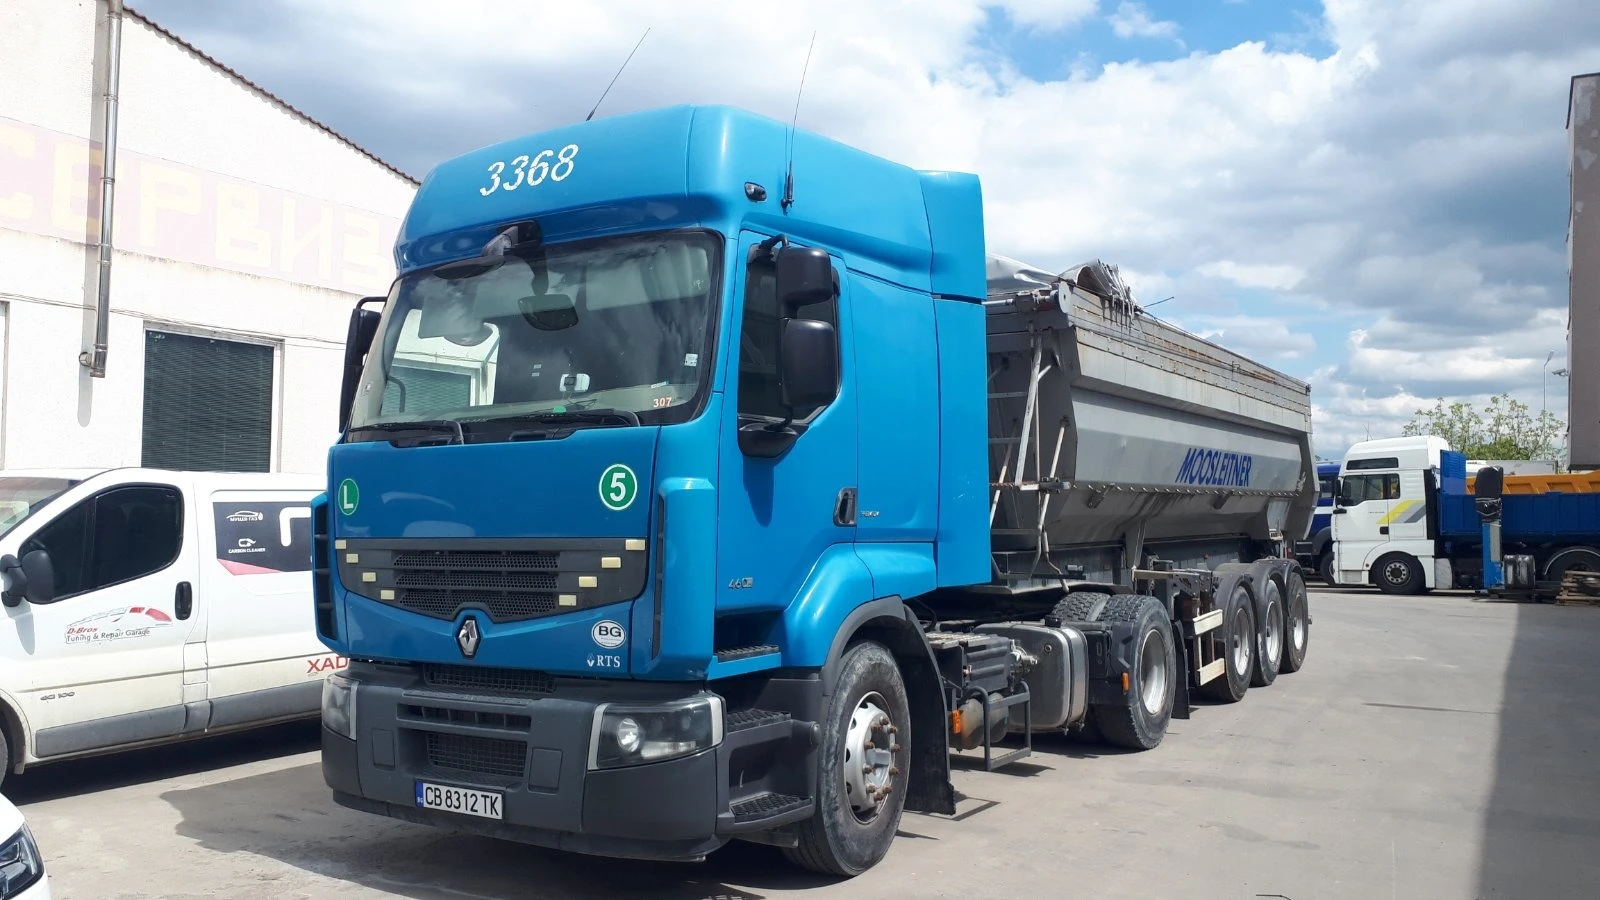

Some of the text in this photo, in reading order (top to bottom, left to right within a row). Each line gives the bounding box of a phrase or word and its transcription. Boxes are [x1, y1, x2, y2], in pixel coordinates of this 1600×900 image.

[480, 144, 579, 196] 3368
[653, 397, 672, 408] 307
[1175, 447, 1252, 487] MOOSLEITNER
[609, 472, 627, 502] 5
[343, 485, 354, 509] L
[66, 634, 91, 642] Tuning
[101, 629, 124, 640] Repair
[125, 627, 151, 638] Garage
[598, 625, 622, 638] BG
[596, 654, 621, 668] RTS
